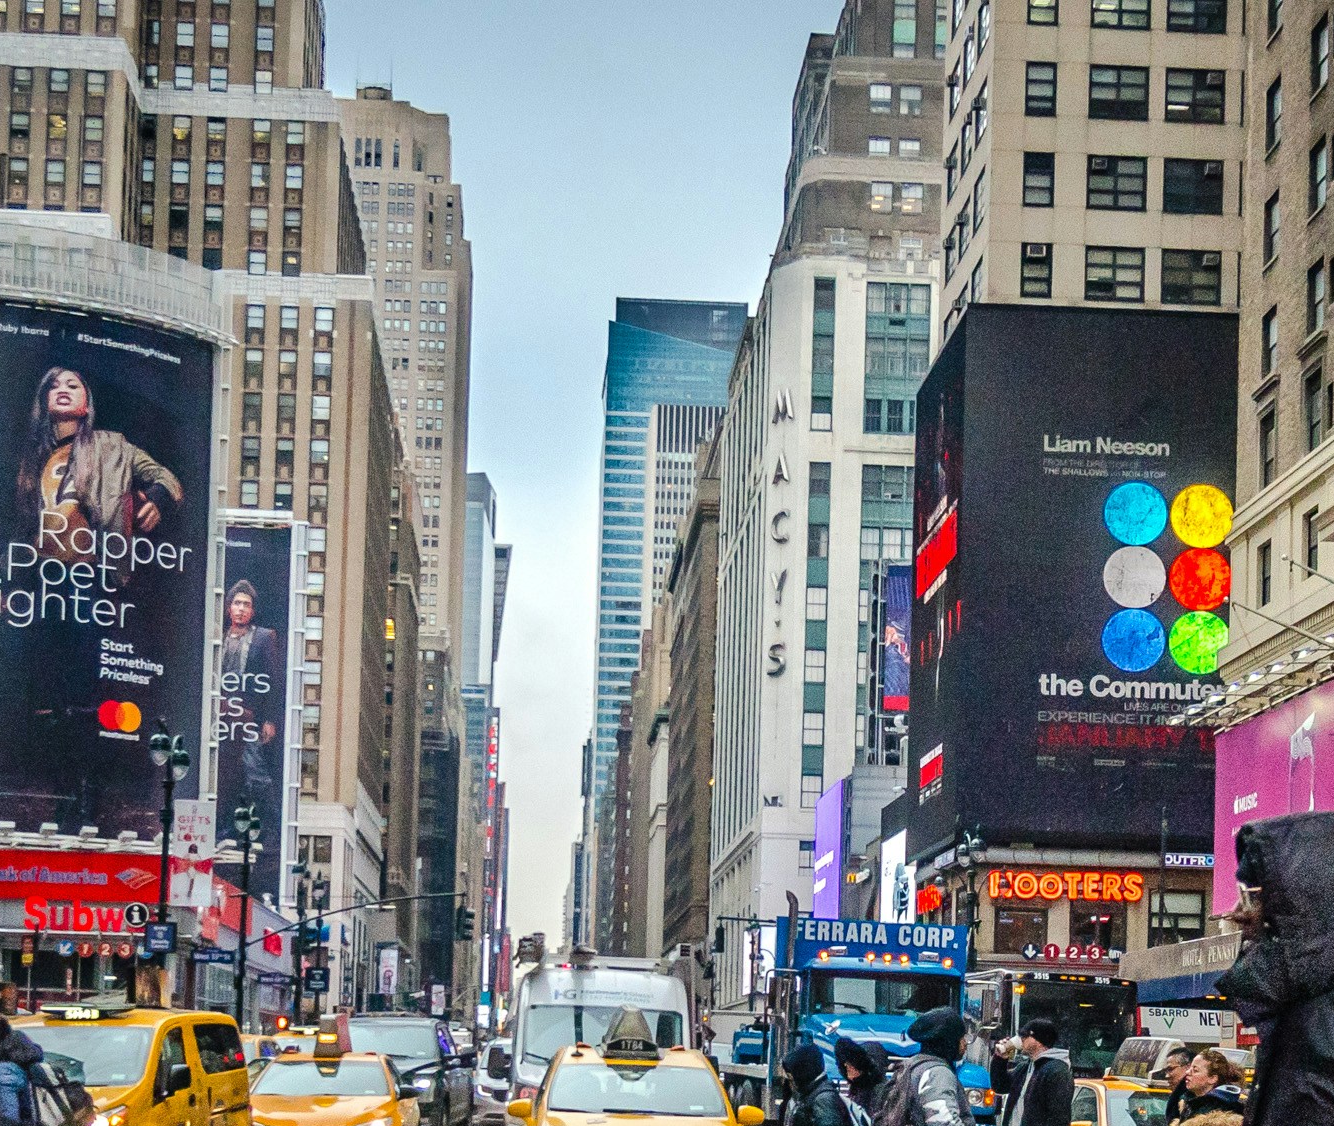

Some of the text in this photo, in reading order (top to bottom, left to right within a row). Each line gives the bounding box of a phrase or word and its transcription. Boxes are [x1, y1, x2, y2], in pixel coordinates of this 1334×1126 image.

[21, 325, 50, 337] Ibarra
[1043, 433, 1170, 457] Liam Neeson
[1043, 467, 1060, 475] THE
[1062, 468, 1109, 477] SHALLOWS
[38, 510, 193, 572] Rapper
[7, 543, 117, 593] Poet
[100, 638, 134, 654] Start
[99, 653, 164, 676] Something
[99, 667, 151, 685] Priceless
[1039, 673, 1084, 696] the
[1038, 711, 1136, 725] EXPERIENCE
[1139, 712, 1152, 725] IT
[1238, 792, 1258, 813] MUSIC
[177, 816, 211, 824] GIFTS
[178, 825, 195, 833] WE
[20, 866, 38, 882] of
[39, 867, 108, 885] America
[987, 870, 1145, 902] HOOTERS
[24, 896, 151, 933] Subw
[796, 919, 959, 949] FERRARA CORP.
[1034, 972, 1110, 985] 3515 3515
[1148, 1008, 1189, 1018] SBARRO
[621, 1040, 643, 1050] 1T84
